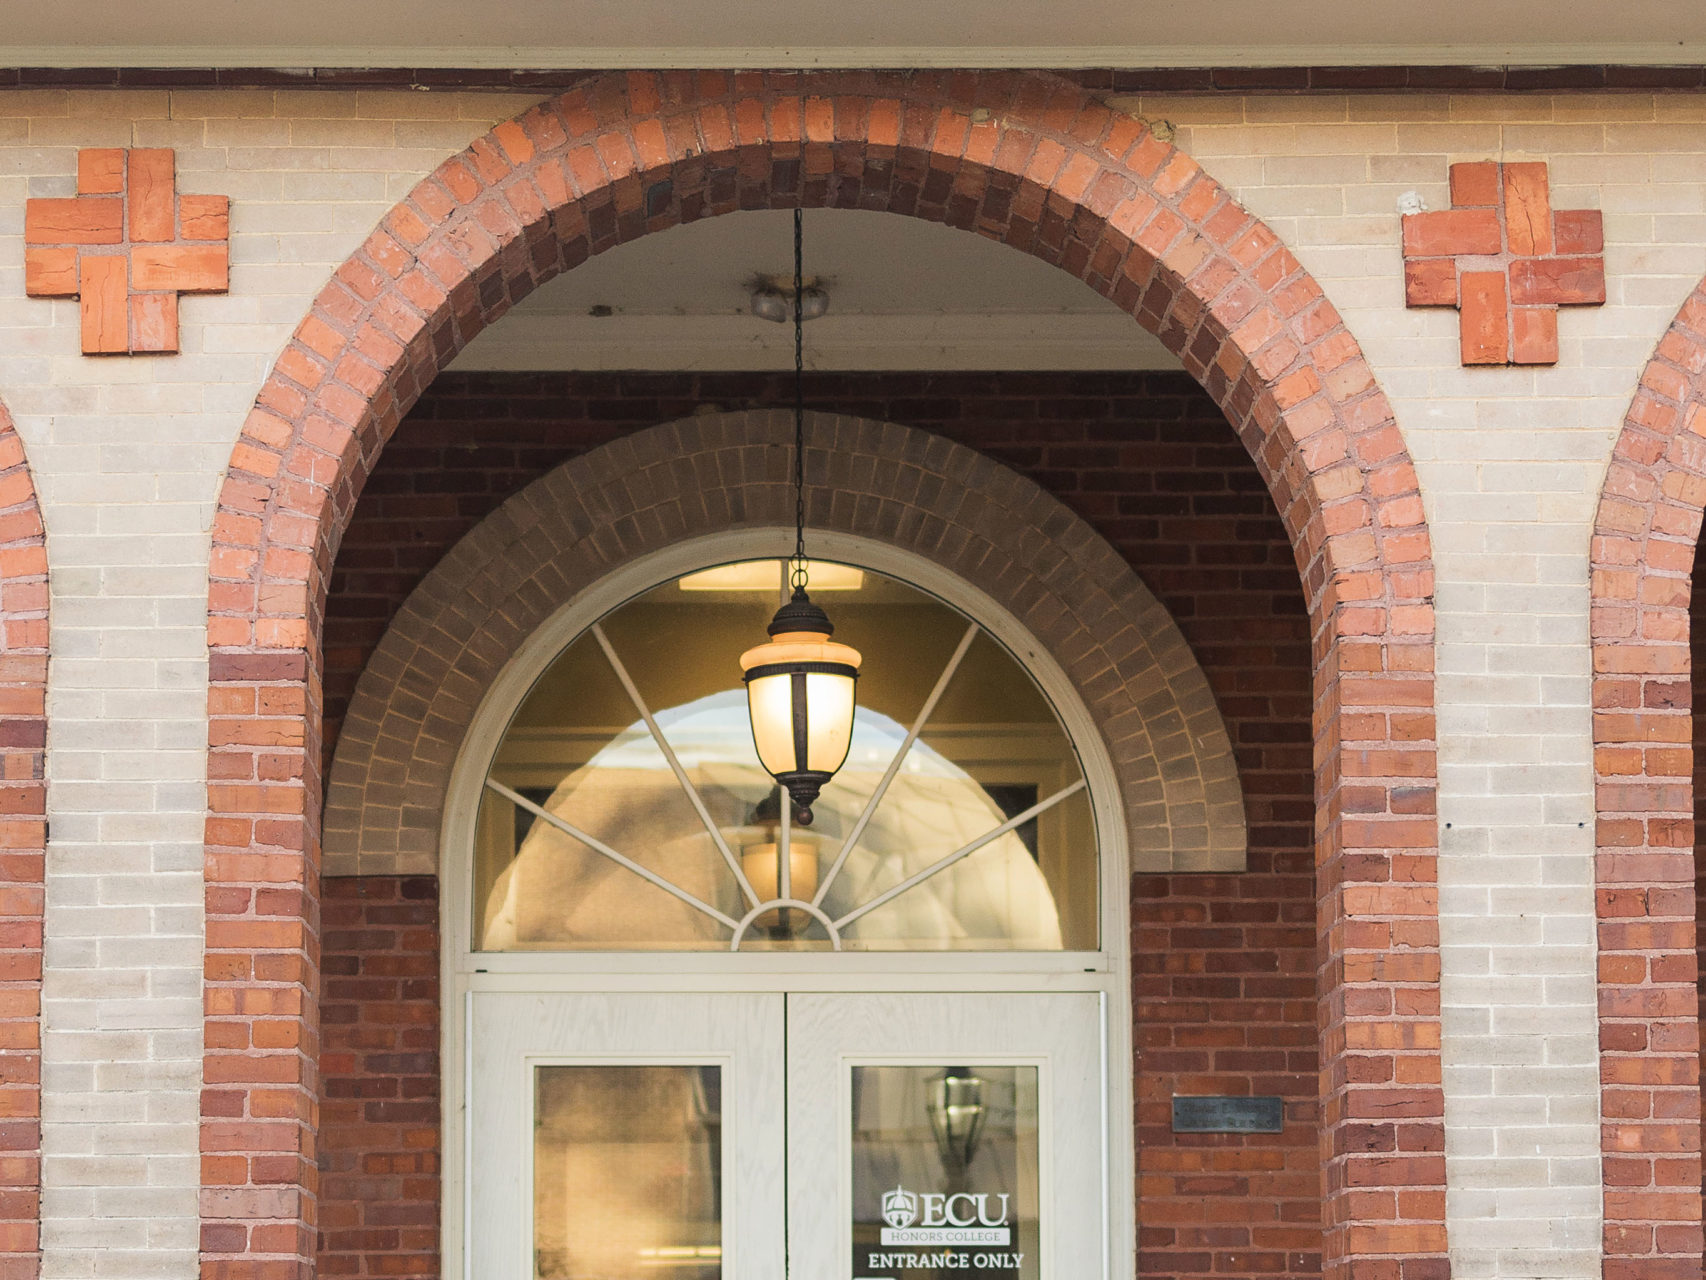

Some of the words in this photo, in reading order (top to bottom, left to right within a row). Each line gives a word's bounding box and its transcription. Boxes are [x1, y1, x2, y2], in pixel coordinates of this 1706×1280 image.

[919, 1193, 1010, 1226] ECU
[891, 1232, 943, 1241] HONORS
[946, 1232, 1000, 1241] COLLEGE
[868, 1253, 969, 1269] ENTRANCE
[973, 1253, 1024, 1269] ONLY
